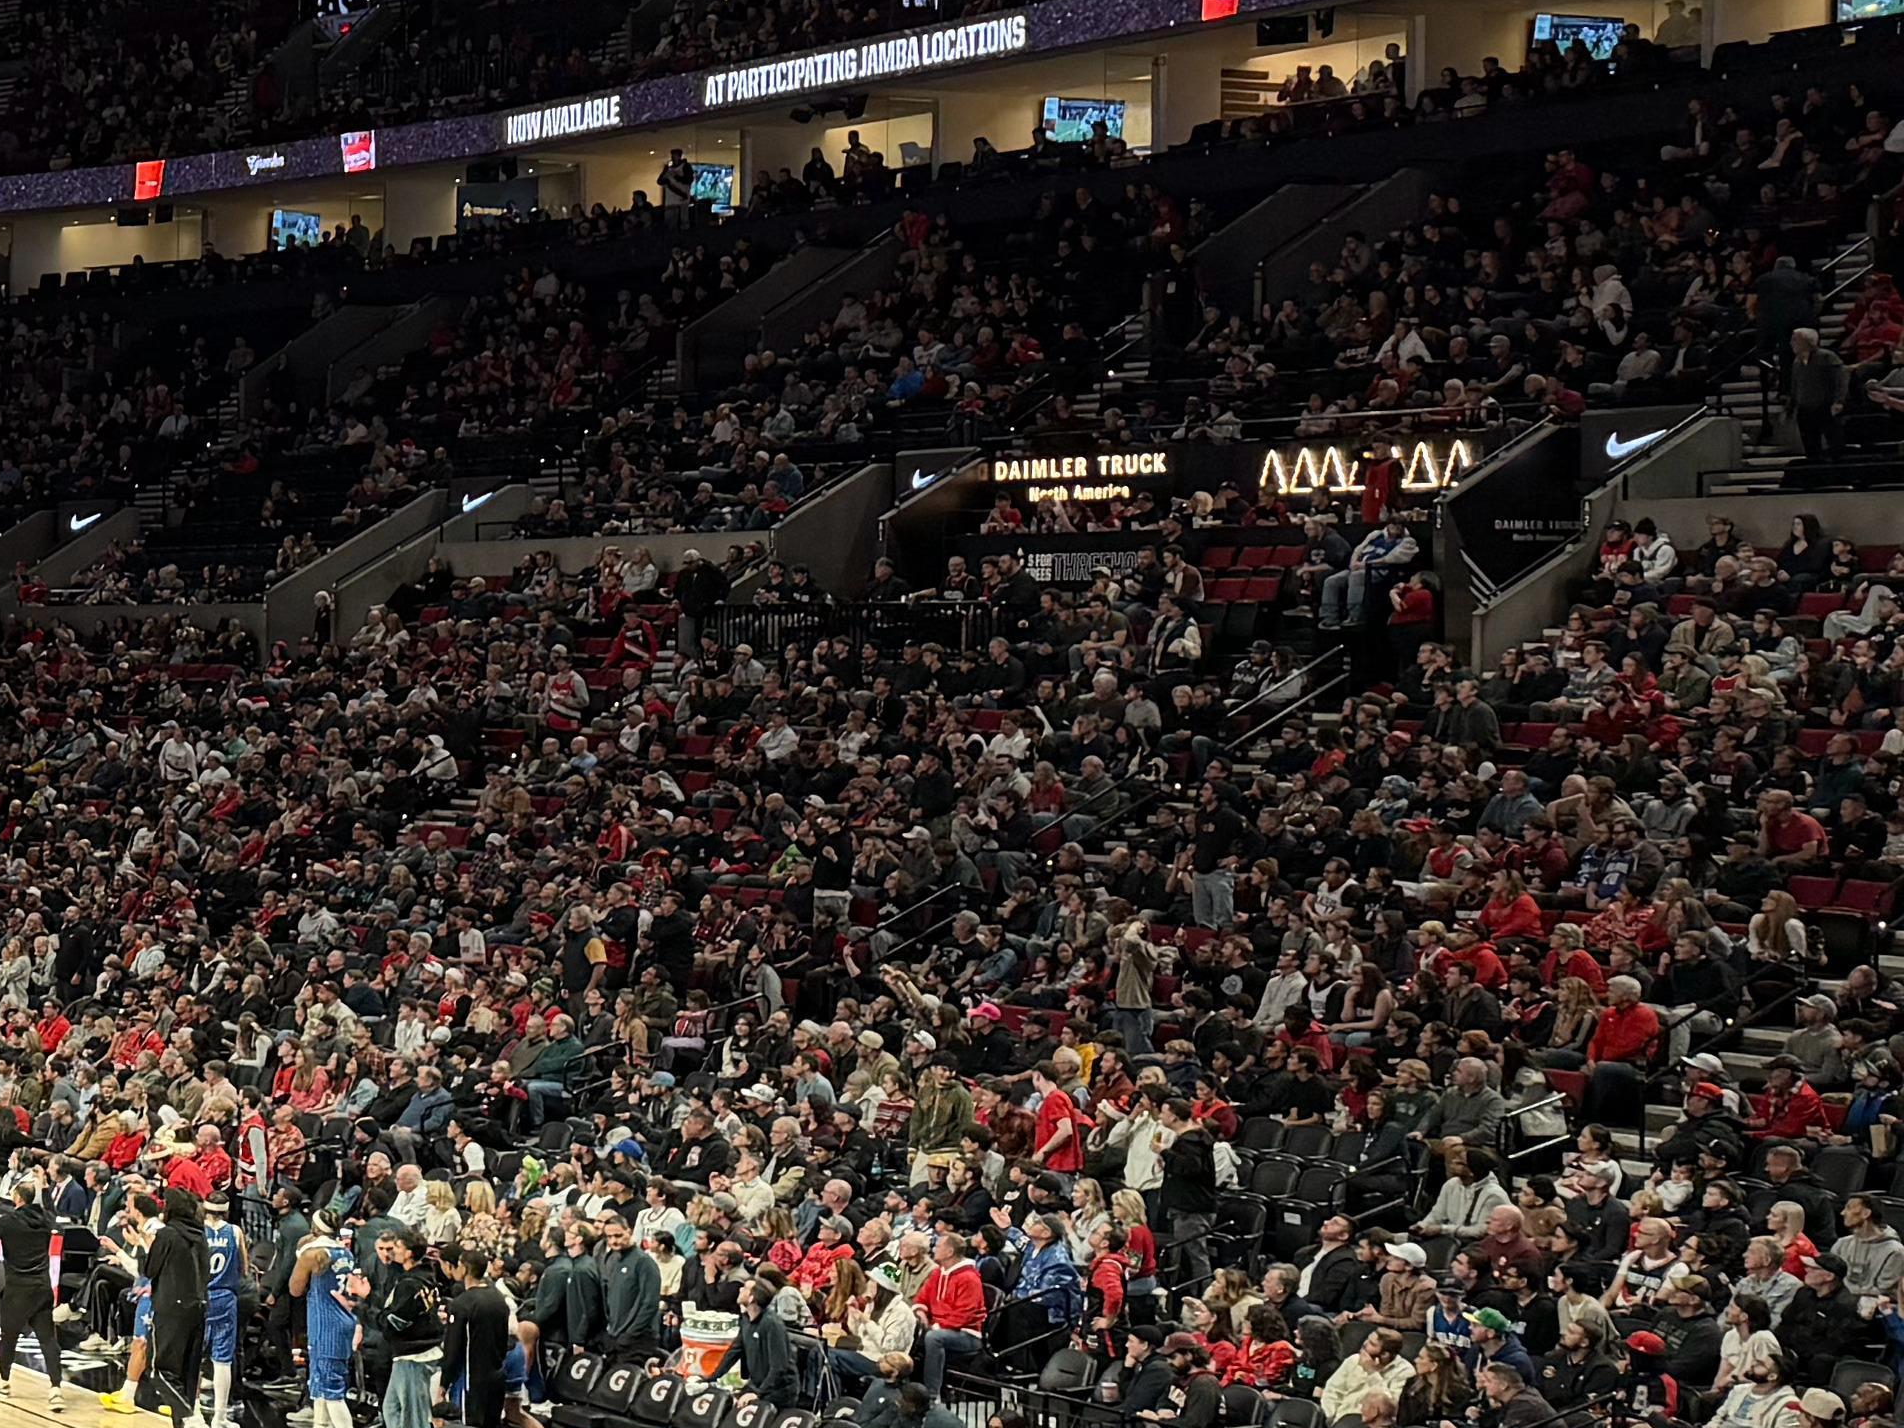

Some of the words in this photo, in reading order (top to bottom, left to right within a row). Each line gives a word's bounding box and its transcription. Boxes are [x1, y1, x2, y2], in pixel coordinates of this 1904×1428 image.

[705, 74, 726, 106] AT
[728, 48, 857, 102] PARTICIPATING
[859, 36, 920, 78] JAMBA
[922, 15, 1026, 64] LOCATIONS
[506, 108, 541, 145] NOW
[542, 94, 621, 138] AVAILABLE
[994, 456, 1087, 481] DAIMLER
[1097, 453, 1167, 476] TRUCK
[1073, 484, 1130, 500] America
